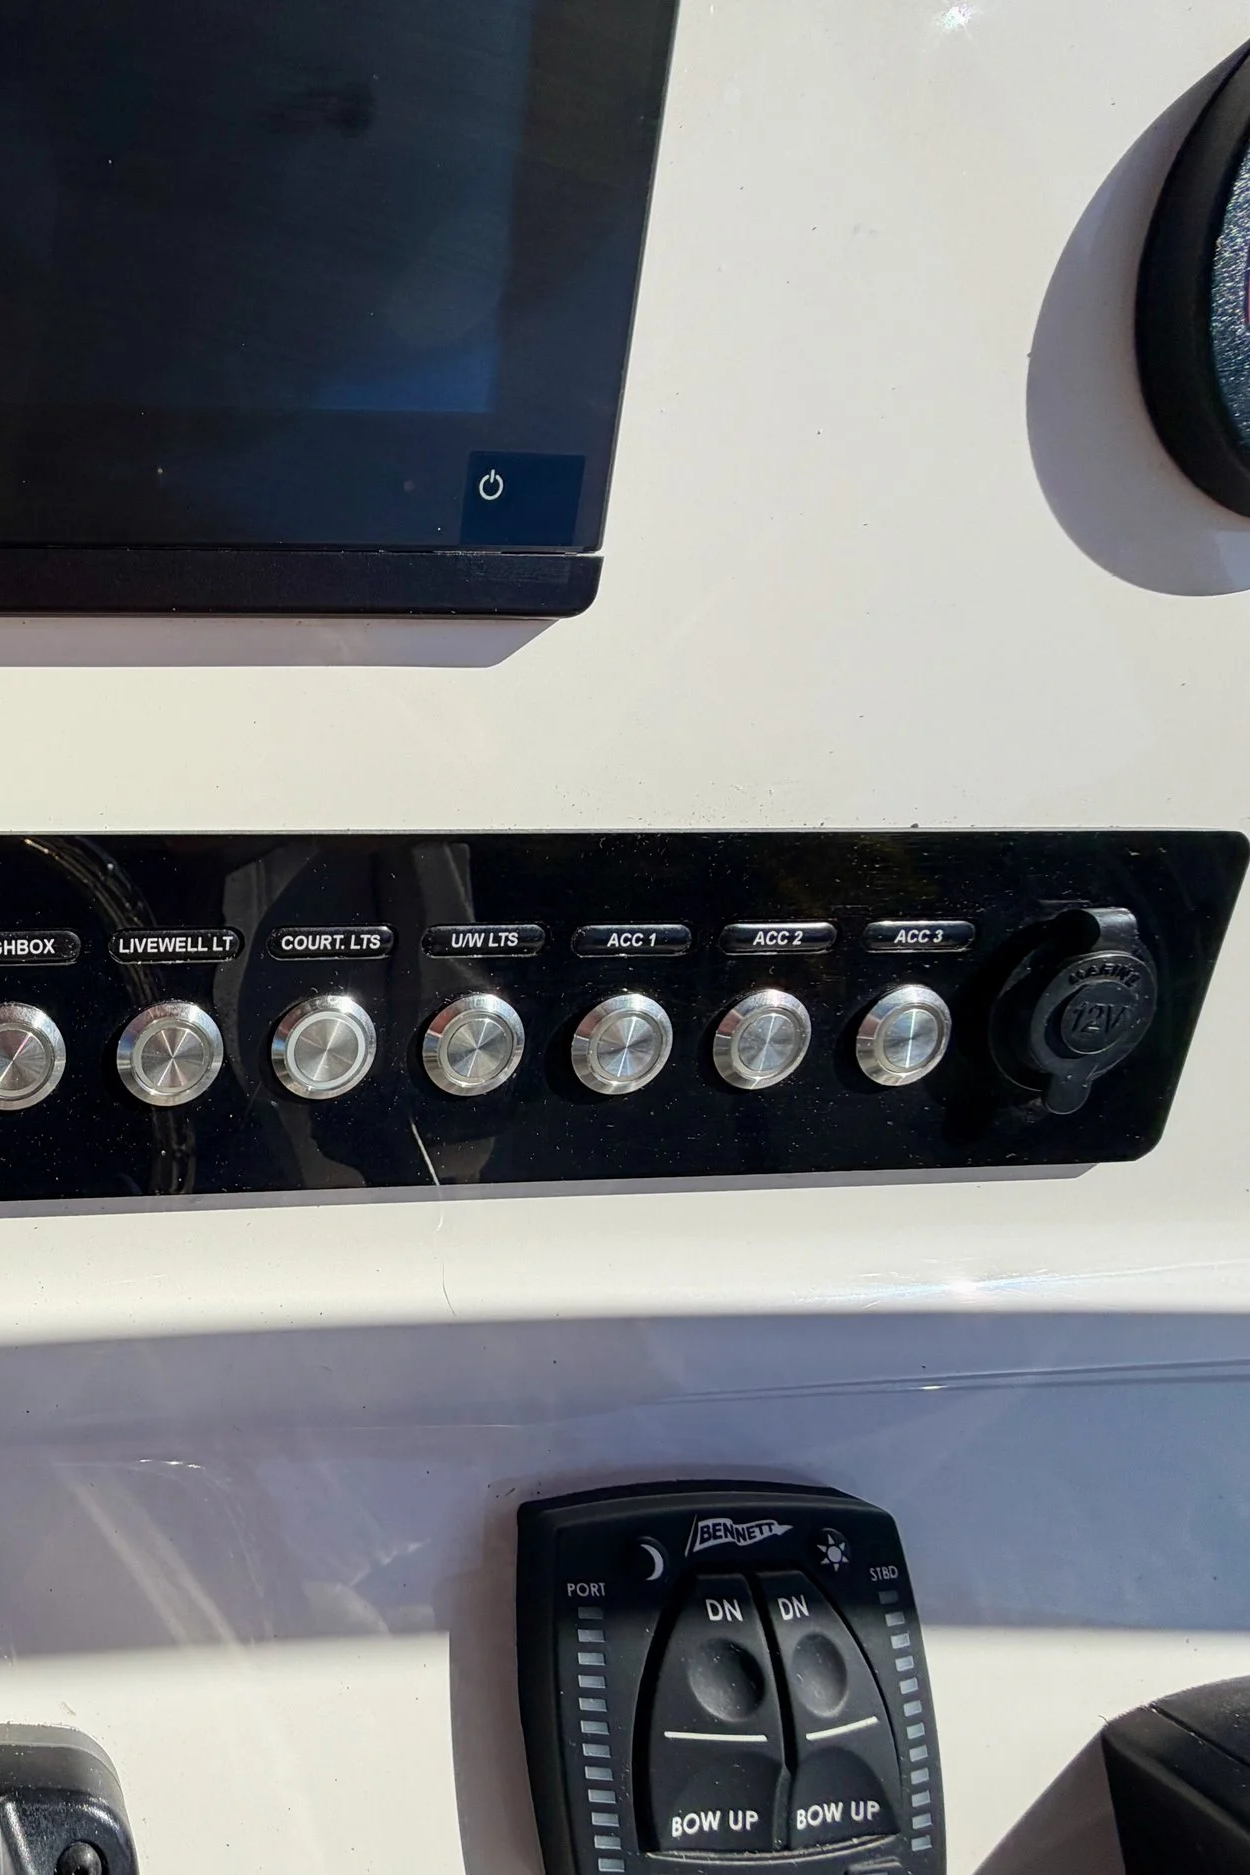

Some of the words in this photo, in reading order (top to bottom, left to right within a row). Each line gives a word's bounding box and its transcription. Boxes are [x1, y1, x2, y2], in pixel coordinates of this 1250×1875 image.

[281, 934, 346, 951] COURT.
[350, 934, 381, 950] LTS
[451, 933, 485, 949] U/W
[488, 932, 519, 947] LTS
[607, 932, 644, 947] ACC
[648, 932, 657, 946] 1
[753, 930, 789, 946] ACC
[792, 930, 803, 945] 2
[894, 929, 931, 944] ACC
[933, 928, 945, 943] 3
[119, 937, 208, 954] LIVEWELL
[213, 936, 234, 951] LT
[1071, 1001, 1131, 1034] 12V
[700, 1520, 776, 1542] BENNETT
[869, 1565, 899, 1582] STBD
[566, 1582, 606, 1598] PORT
[706, 1598, 744, 1622] DN
[777, 1594, 810, 1621] DN
[796, 1802, 844, 1830] BOW
[850, 1800, 881, 1821] UP
[671, 1811, 721, 1838] BOW
[728, 1810, 759, 1831] UP
